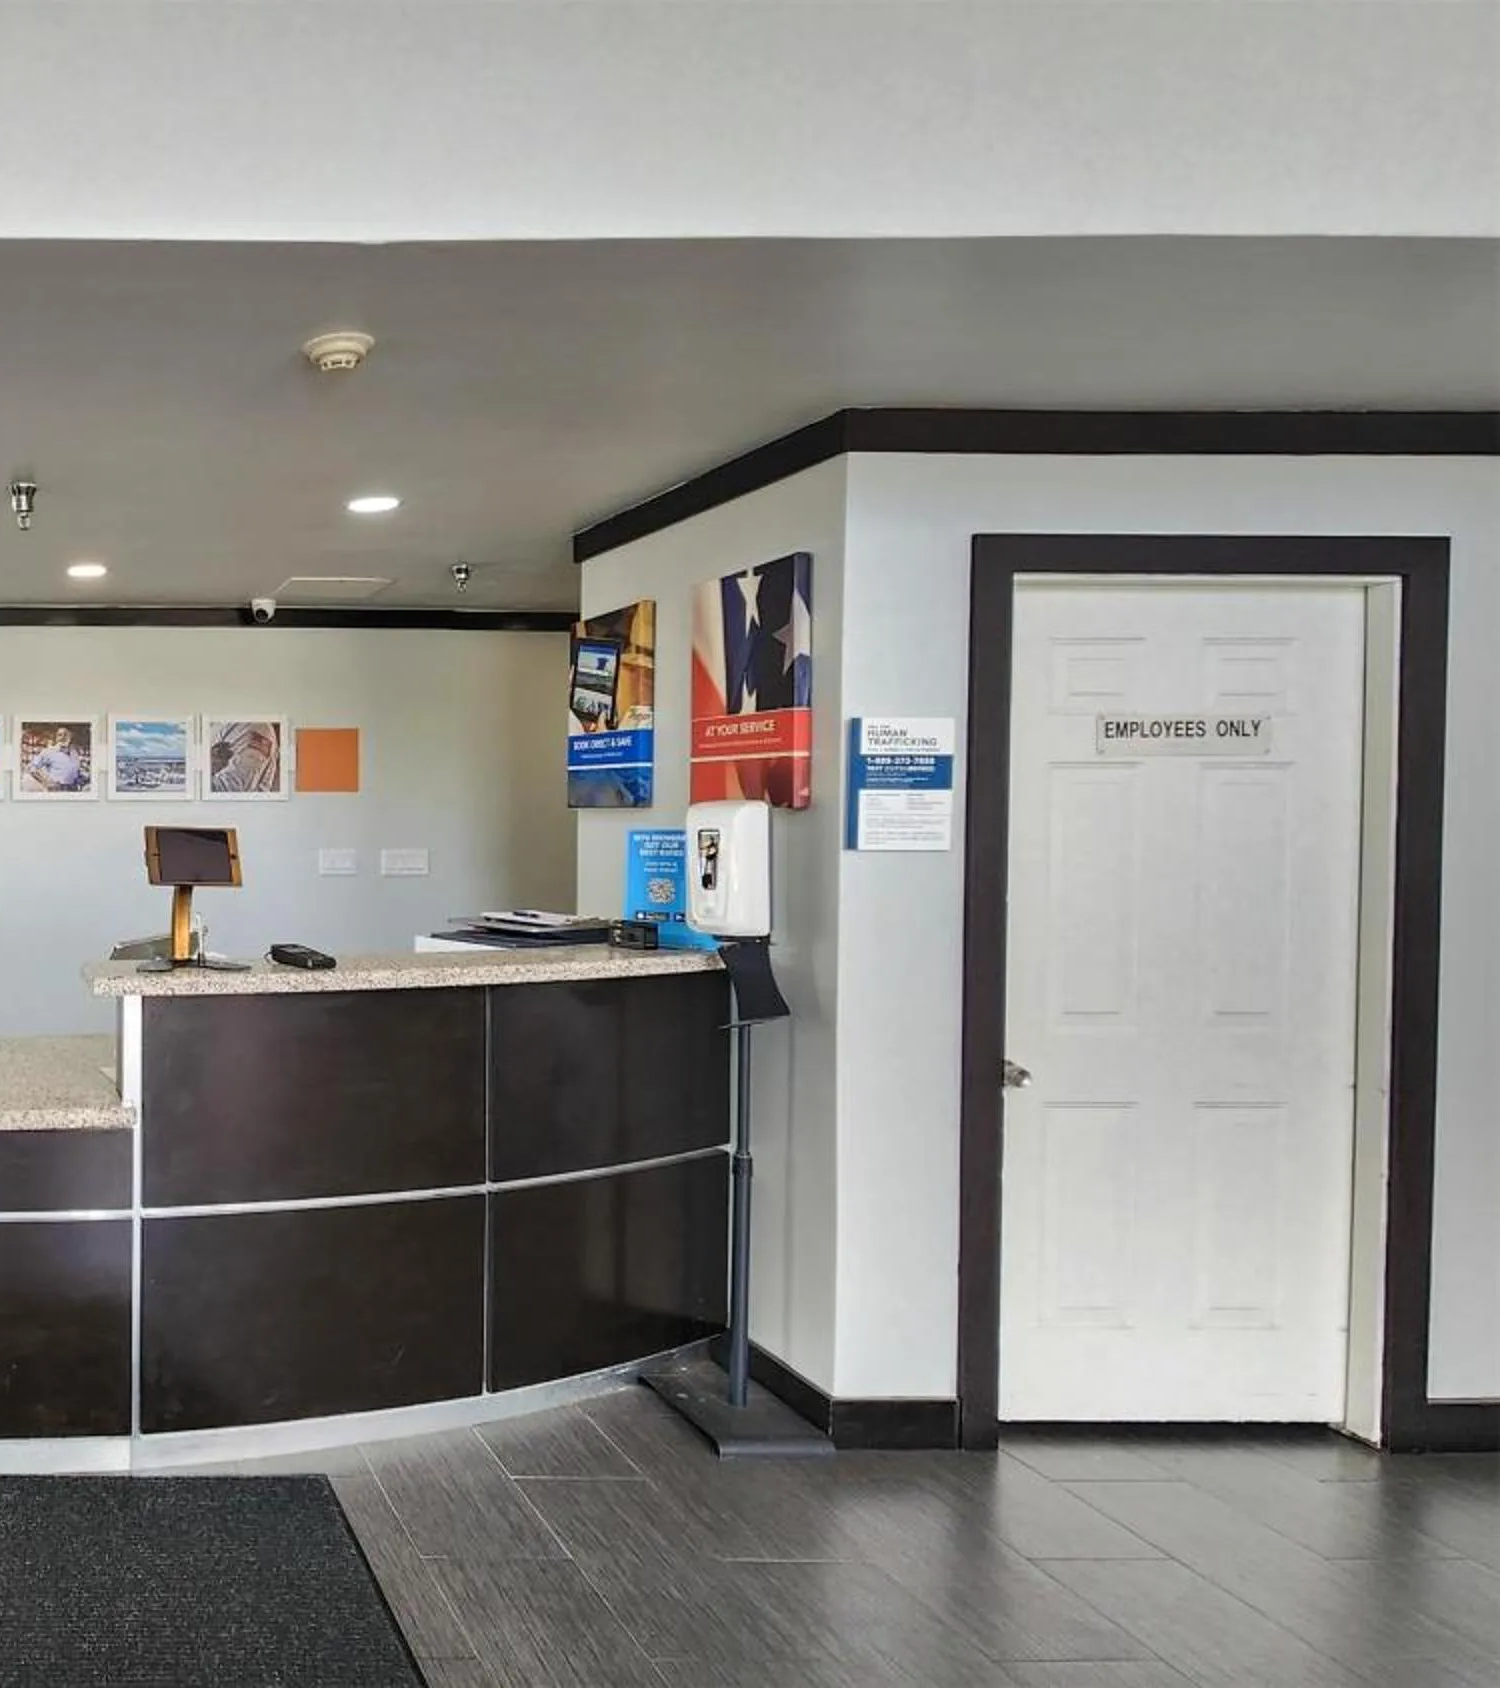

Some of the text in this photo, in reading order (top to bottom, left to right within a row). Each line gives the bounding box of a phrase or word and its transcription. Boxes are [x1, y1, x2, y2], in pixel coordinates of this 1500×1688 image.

[716, 723, 739, 736] YOUR
[740, 719, 776, 735] SERVICE
[1104, 719, 1262, 739] EMPLOYEES ONLY
[867, 738, 938, 746] TRAFFICKING
